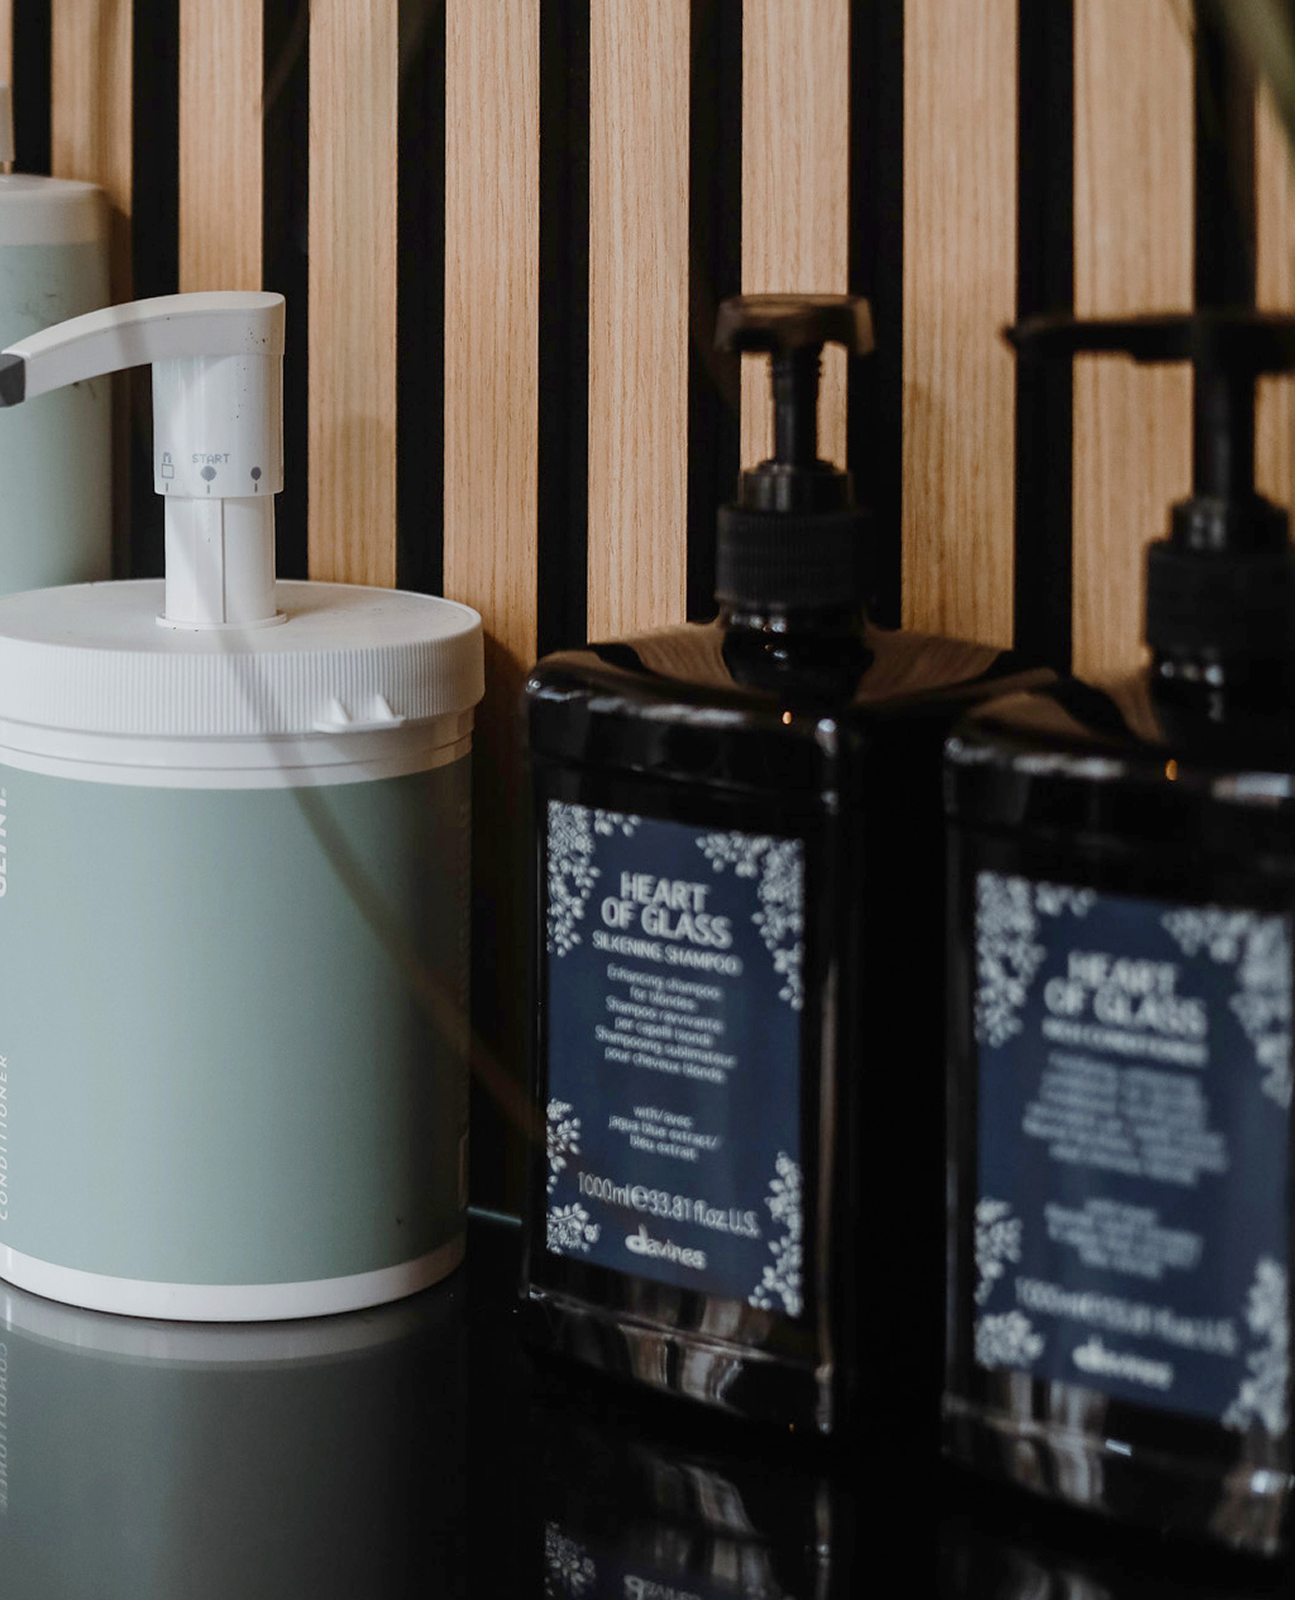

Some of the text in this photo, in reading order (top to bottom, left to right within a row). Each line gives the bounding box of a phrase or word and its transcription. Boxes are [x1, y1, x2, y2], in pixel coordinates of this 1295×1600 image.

[192, 453, 231, 464] START
[620, 870, 710, 914] HEART
[601, 896, 733, 949] OF GLASS
[592, 929, 743, 977] SILKENING SHAMPOO
[606, 995, 657, 1020] Shampoo
[625, 1223, 706, 1270] davines
